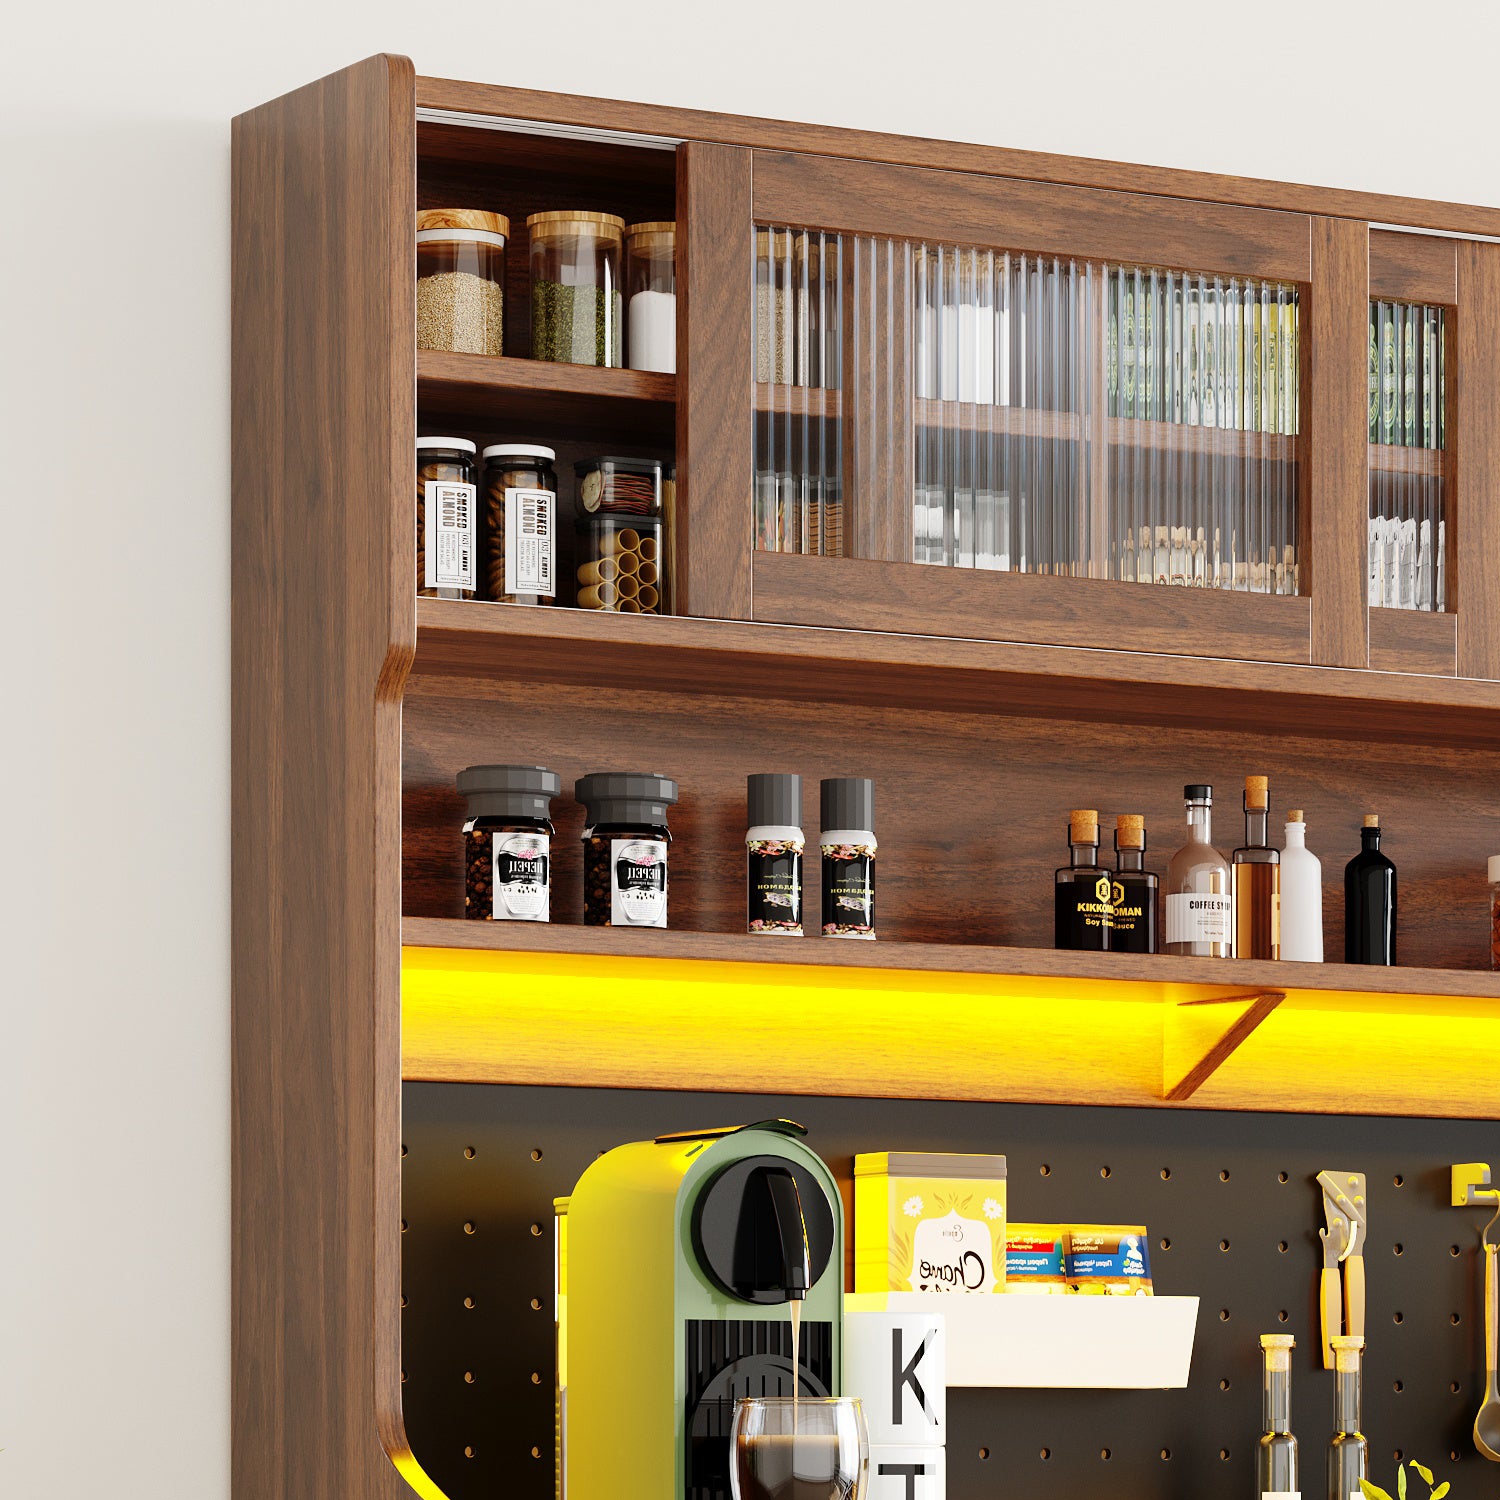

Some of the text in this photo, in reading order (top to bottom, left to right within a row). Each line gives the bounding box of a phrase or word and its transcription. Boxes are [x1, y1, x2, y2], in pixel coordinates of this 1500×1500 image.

[443, 491, 455, 527] ALMOND
[456, 492, 467, 529] SMOKED
[523, 498, 535, 534] ALMOND
[536, 499, 547, 536] SMOKED
[1085, 918, 1100, 927] Soy
[1189, 900, 1215, 910] COFFEE
[892, 1328, 938, 1426] K
